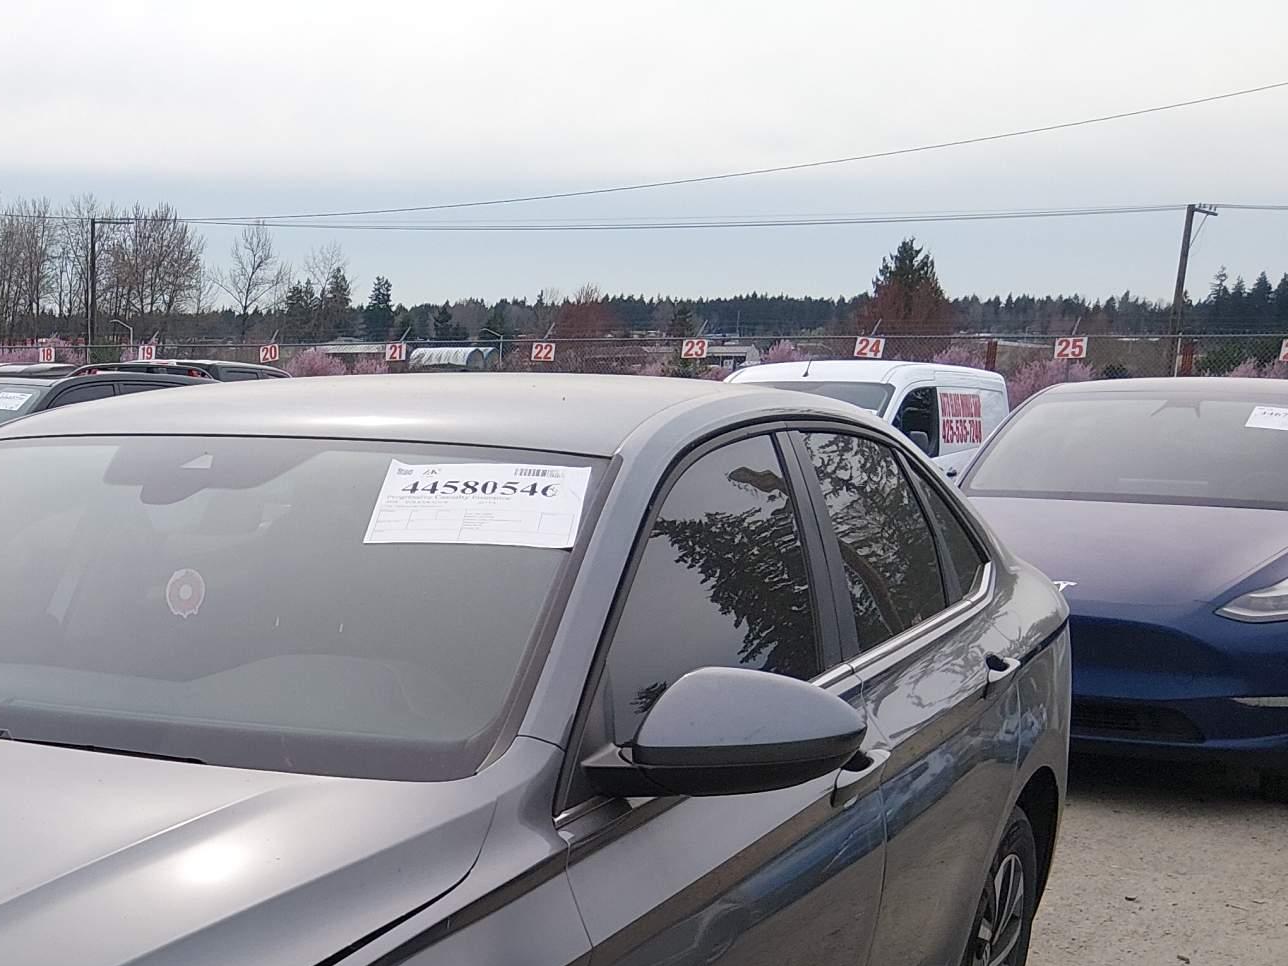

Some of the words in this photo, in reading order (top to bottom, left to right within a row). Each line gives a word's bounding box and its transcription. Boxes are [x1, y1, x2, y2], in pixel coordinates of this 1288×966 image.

[42, 348, 52, 361] 18
[142, 346, 153, 360] 19
[261, 344, 277, 361] 20
[389, 344, 402, 360] 21
[534, 343, 553, 360] 22
[683, 340, 706, 357] 23
[856, 338, 881, 357] 24
[1056, 338, 1084, 358] 25
[401, 480, 561, 498] 44580546
